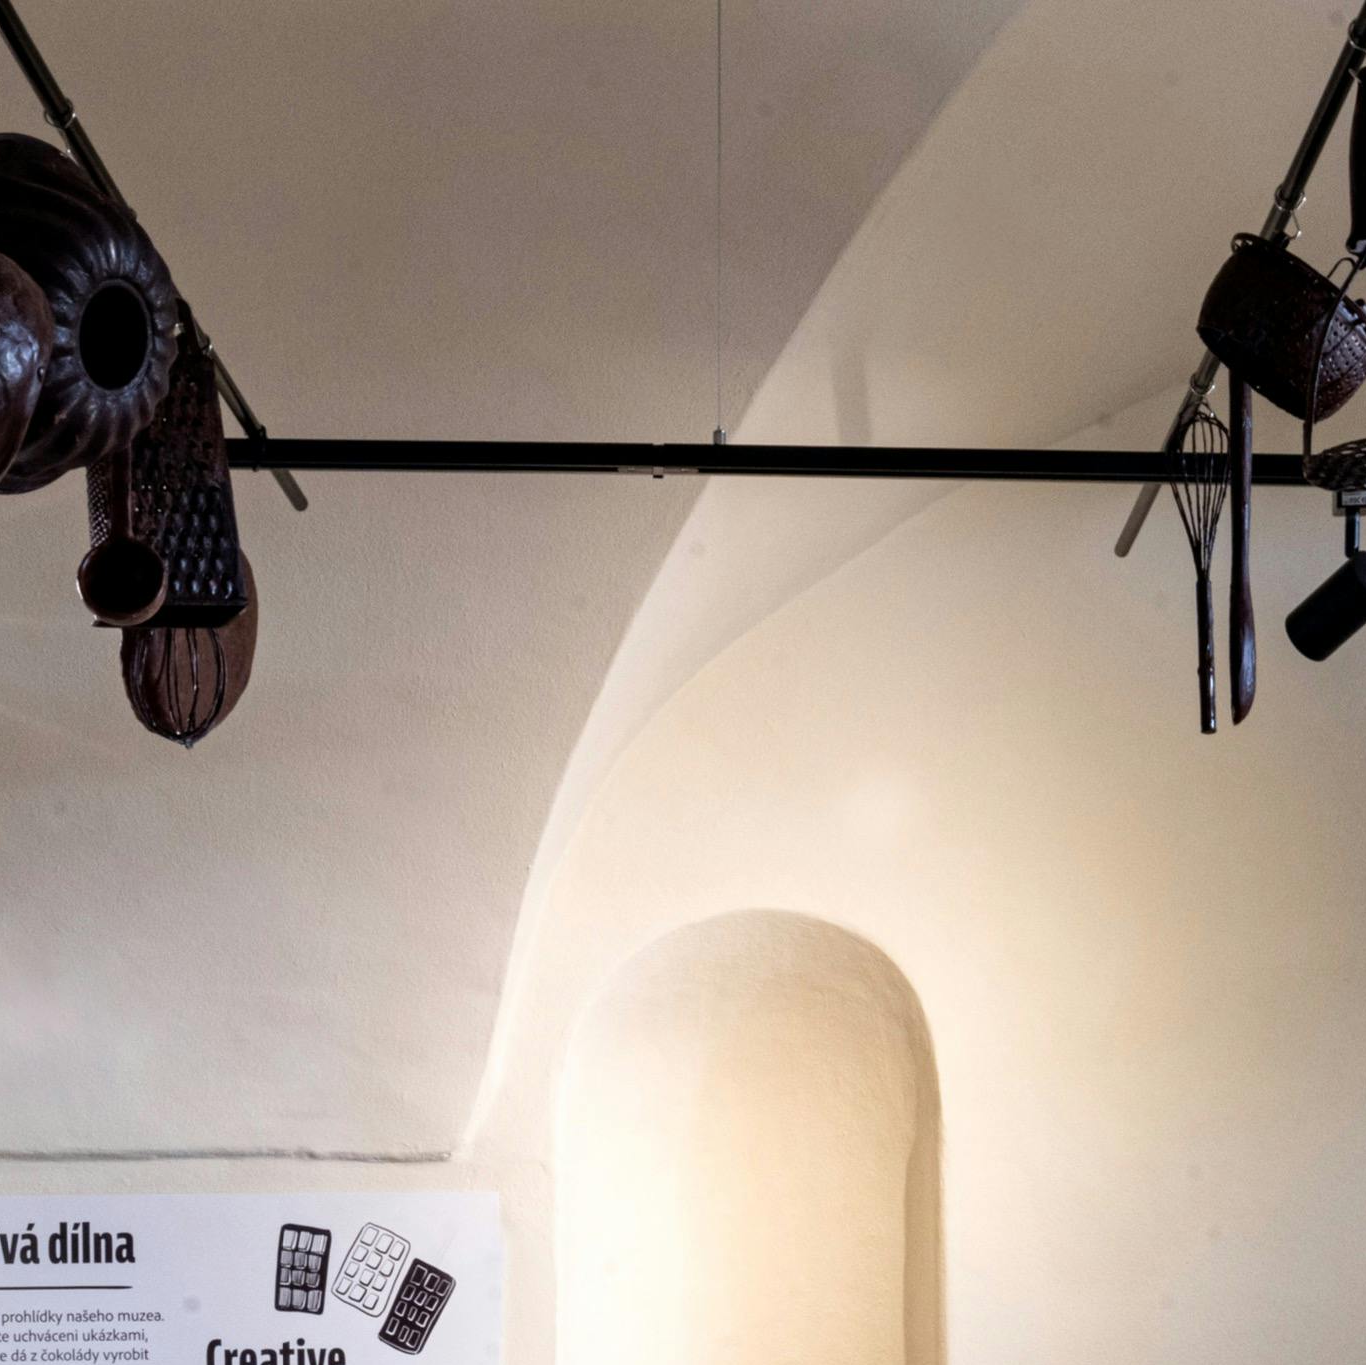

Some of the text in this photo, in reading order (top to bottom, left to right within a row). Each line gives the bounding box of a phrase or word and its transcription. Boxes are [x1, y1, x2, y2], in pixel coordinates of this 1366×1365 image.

[48, 1222, 135, 1264] dílna
[2, 1310, 63, 1326] prohlídky
[67, 1309, 114, 1322] našeho
[118, 1312, 164, 1322] muzea.
[13, 1330, 78, 1342] uchváceni
[82, 1329, 148, 1343] ukázkami,
[11, 1349, 27, 1362] dá
[30, 1352, 37, 1361] z
[40, 1348, 99, 1364] čokolády
[103, 1348, 149, 1364] vyrobit
